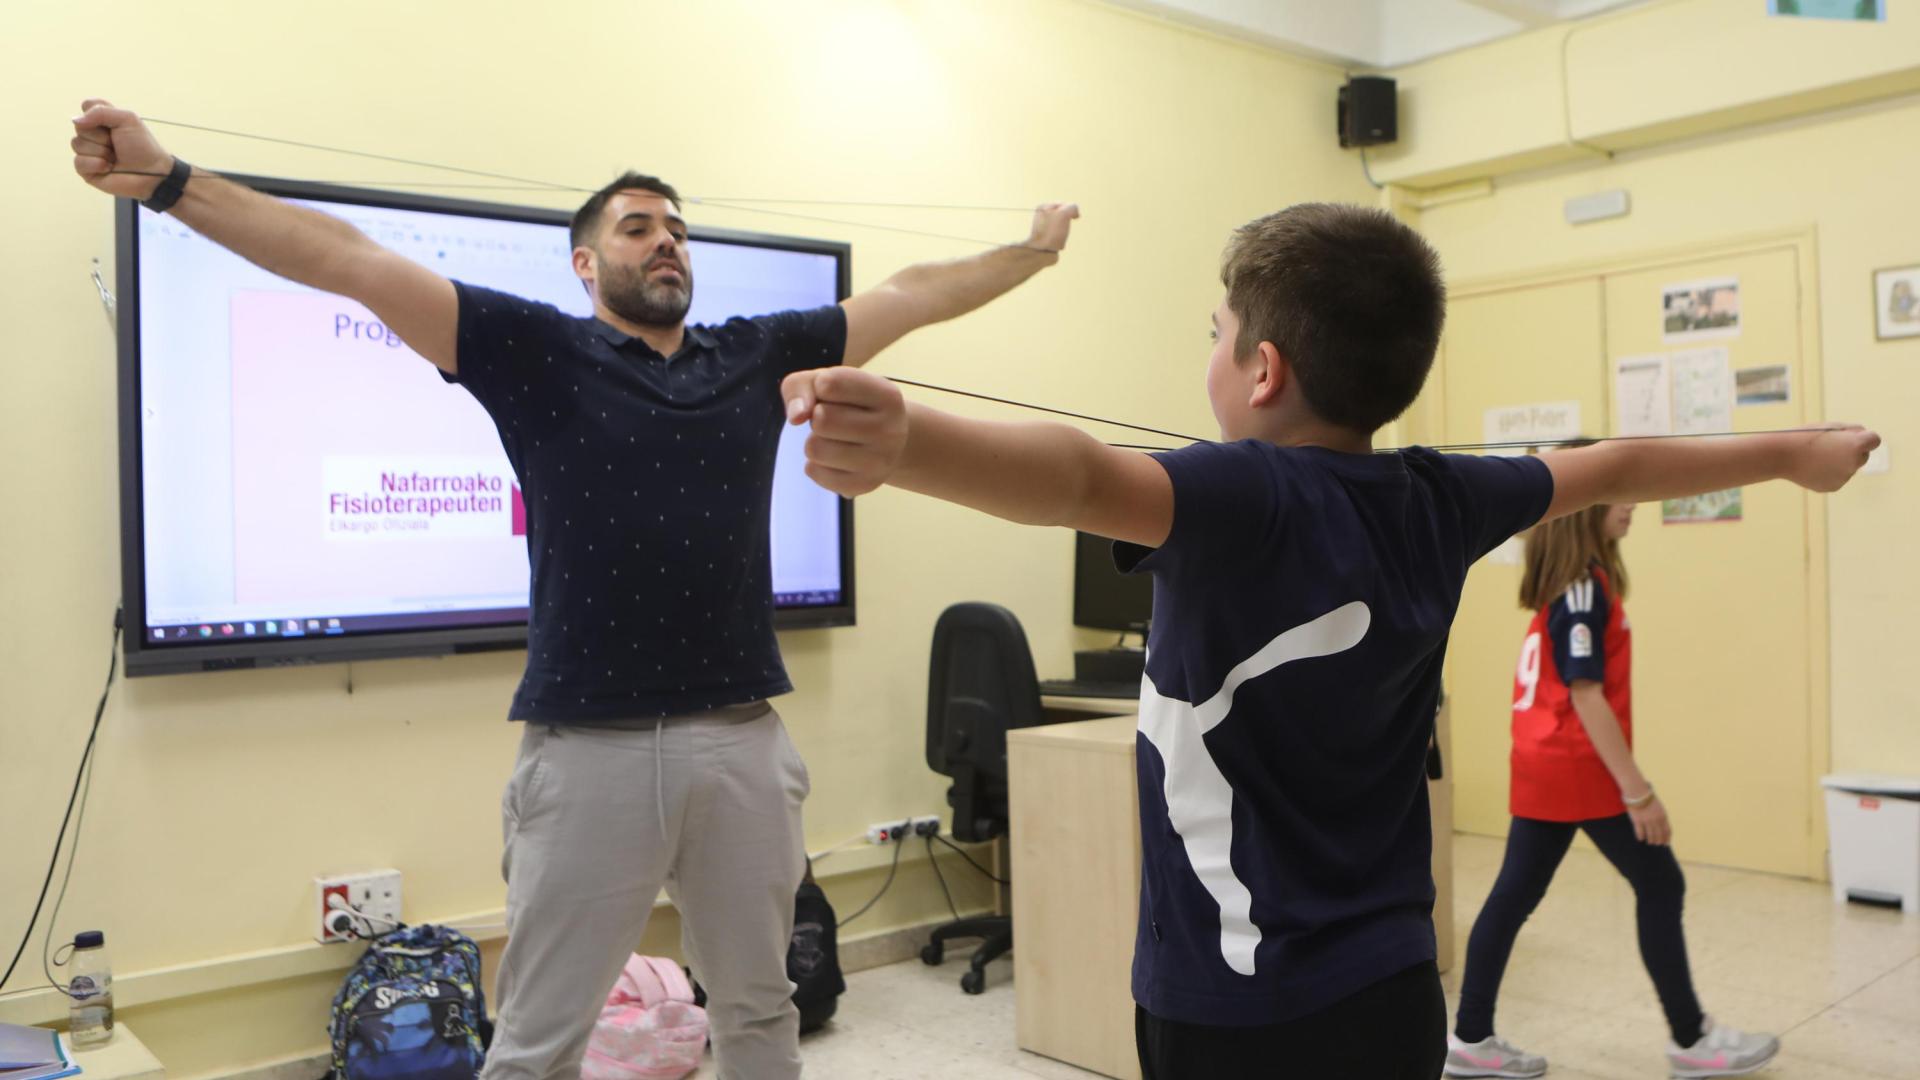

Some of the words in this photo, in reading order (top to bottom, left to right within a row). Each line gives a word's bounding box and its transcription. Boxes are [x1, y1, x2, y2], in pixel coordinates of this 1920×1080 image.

[381, 472, 503, 492] Nafarroako
[330, 493, 503, 516] Fisioterapeuten
[1512, 632, 1541, 712] 9
